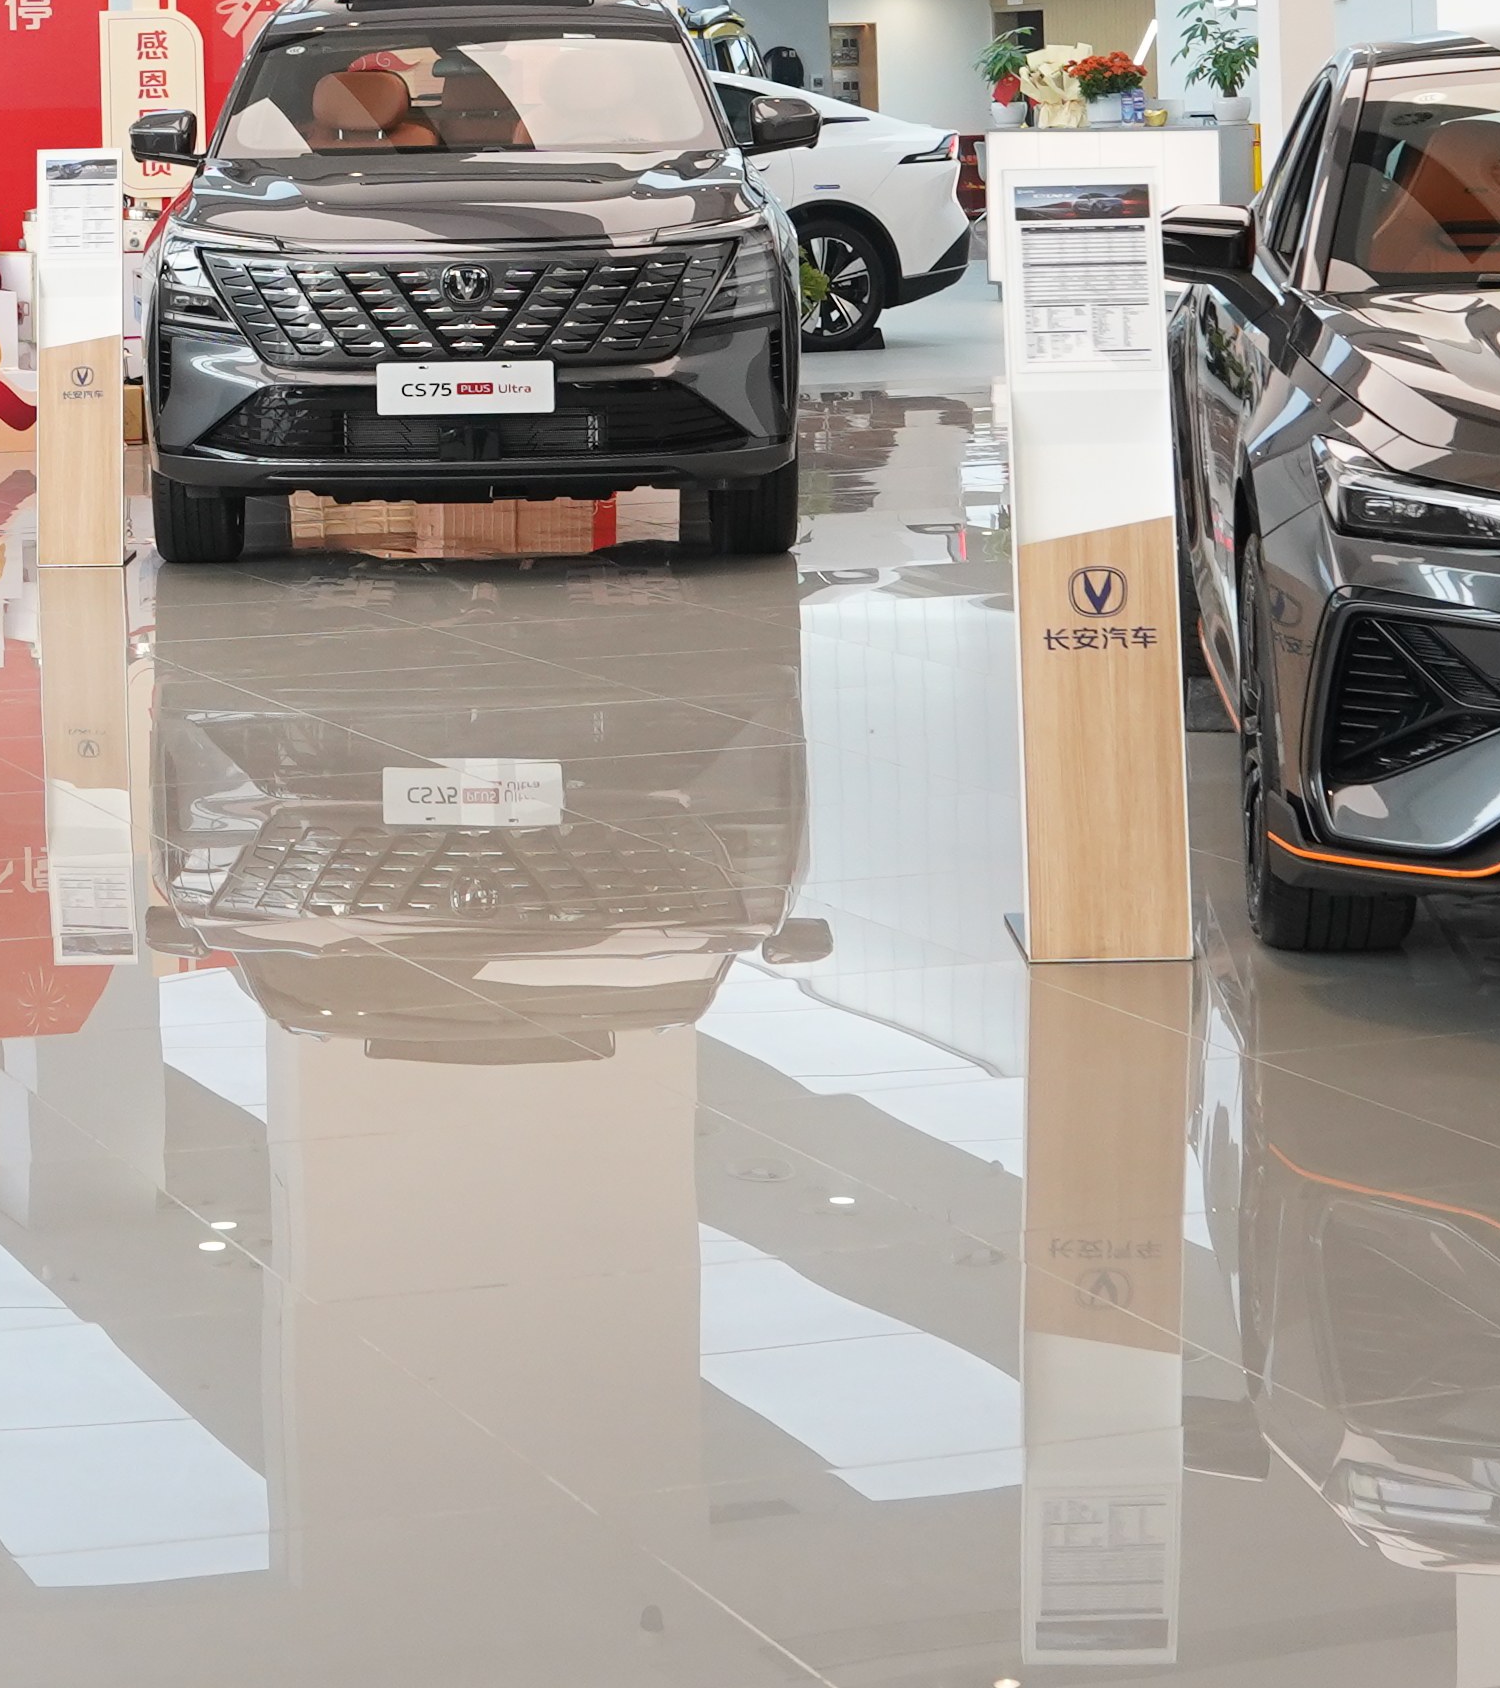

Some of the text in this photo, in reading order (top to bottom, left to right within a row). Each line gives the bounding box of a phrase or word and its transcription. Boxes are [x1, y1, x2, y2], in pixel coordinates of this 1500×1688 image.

[401, 383, 532, 397] CS75 PLUS Ultra
[1043, 627, 1158, 650] 长安汽车
